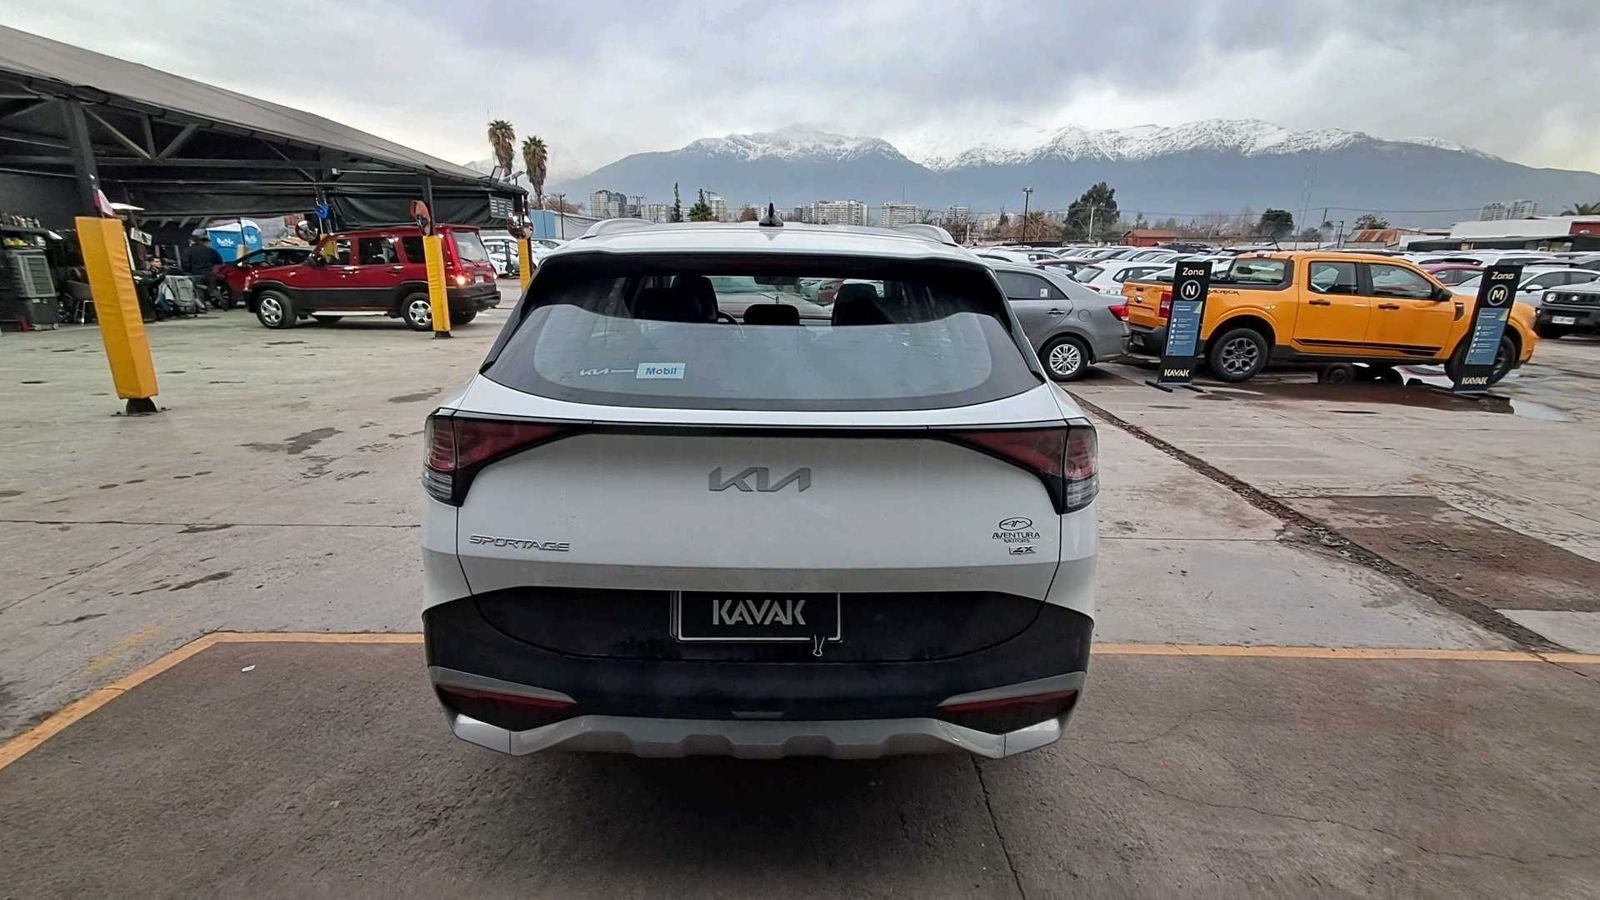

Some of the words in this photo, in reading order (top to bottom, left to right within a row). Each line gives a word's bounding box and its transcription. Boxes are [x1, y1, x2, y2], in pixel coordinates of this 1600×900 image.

[1182, 267, 1204, 276] Zona
[1491, 271, 1515, 280] Zona
[1185, 285, 1196, 296] N
[1491, 290, 1504, 301] M
[645, 367, 677, 375] Mobil
[1164, 369, 1189, 377] KAVAK
[1461, 377, 1488, 385] KAVAK
[708, 466, 811, 493] KIA
[469, 534, 570, 552] SPORTAGE
[712, 599, 807, 625] KAVAK
